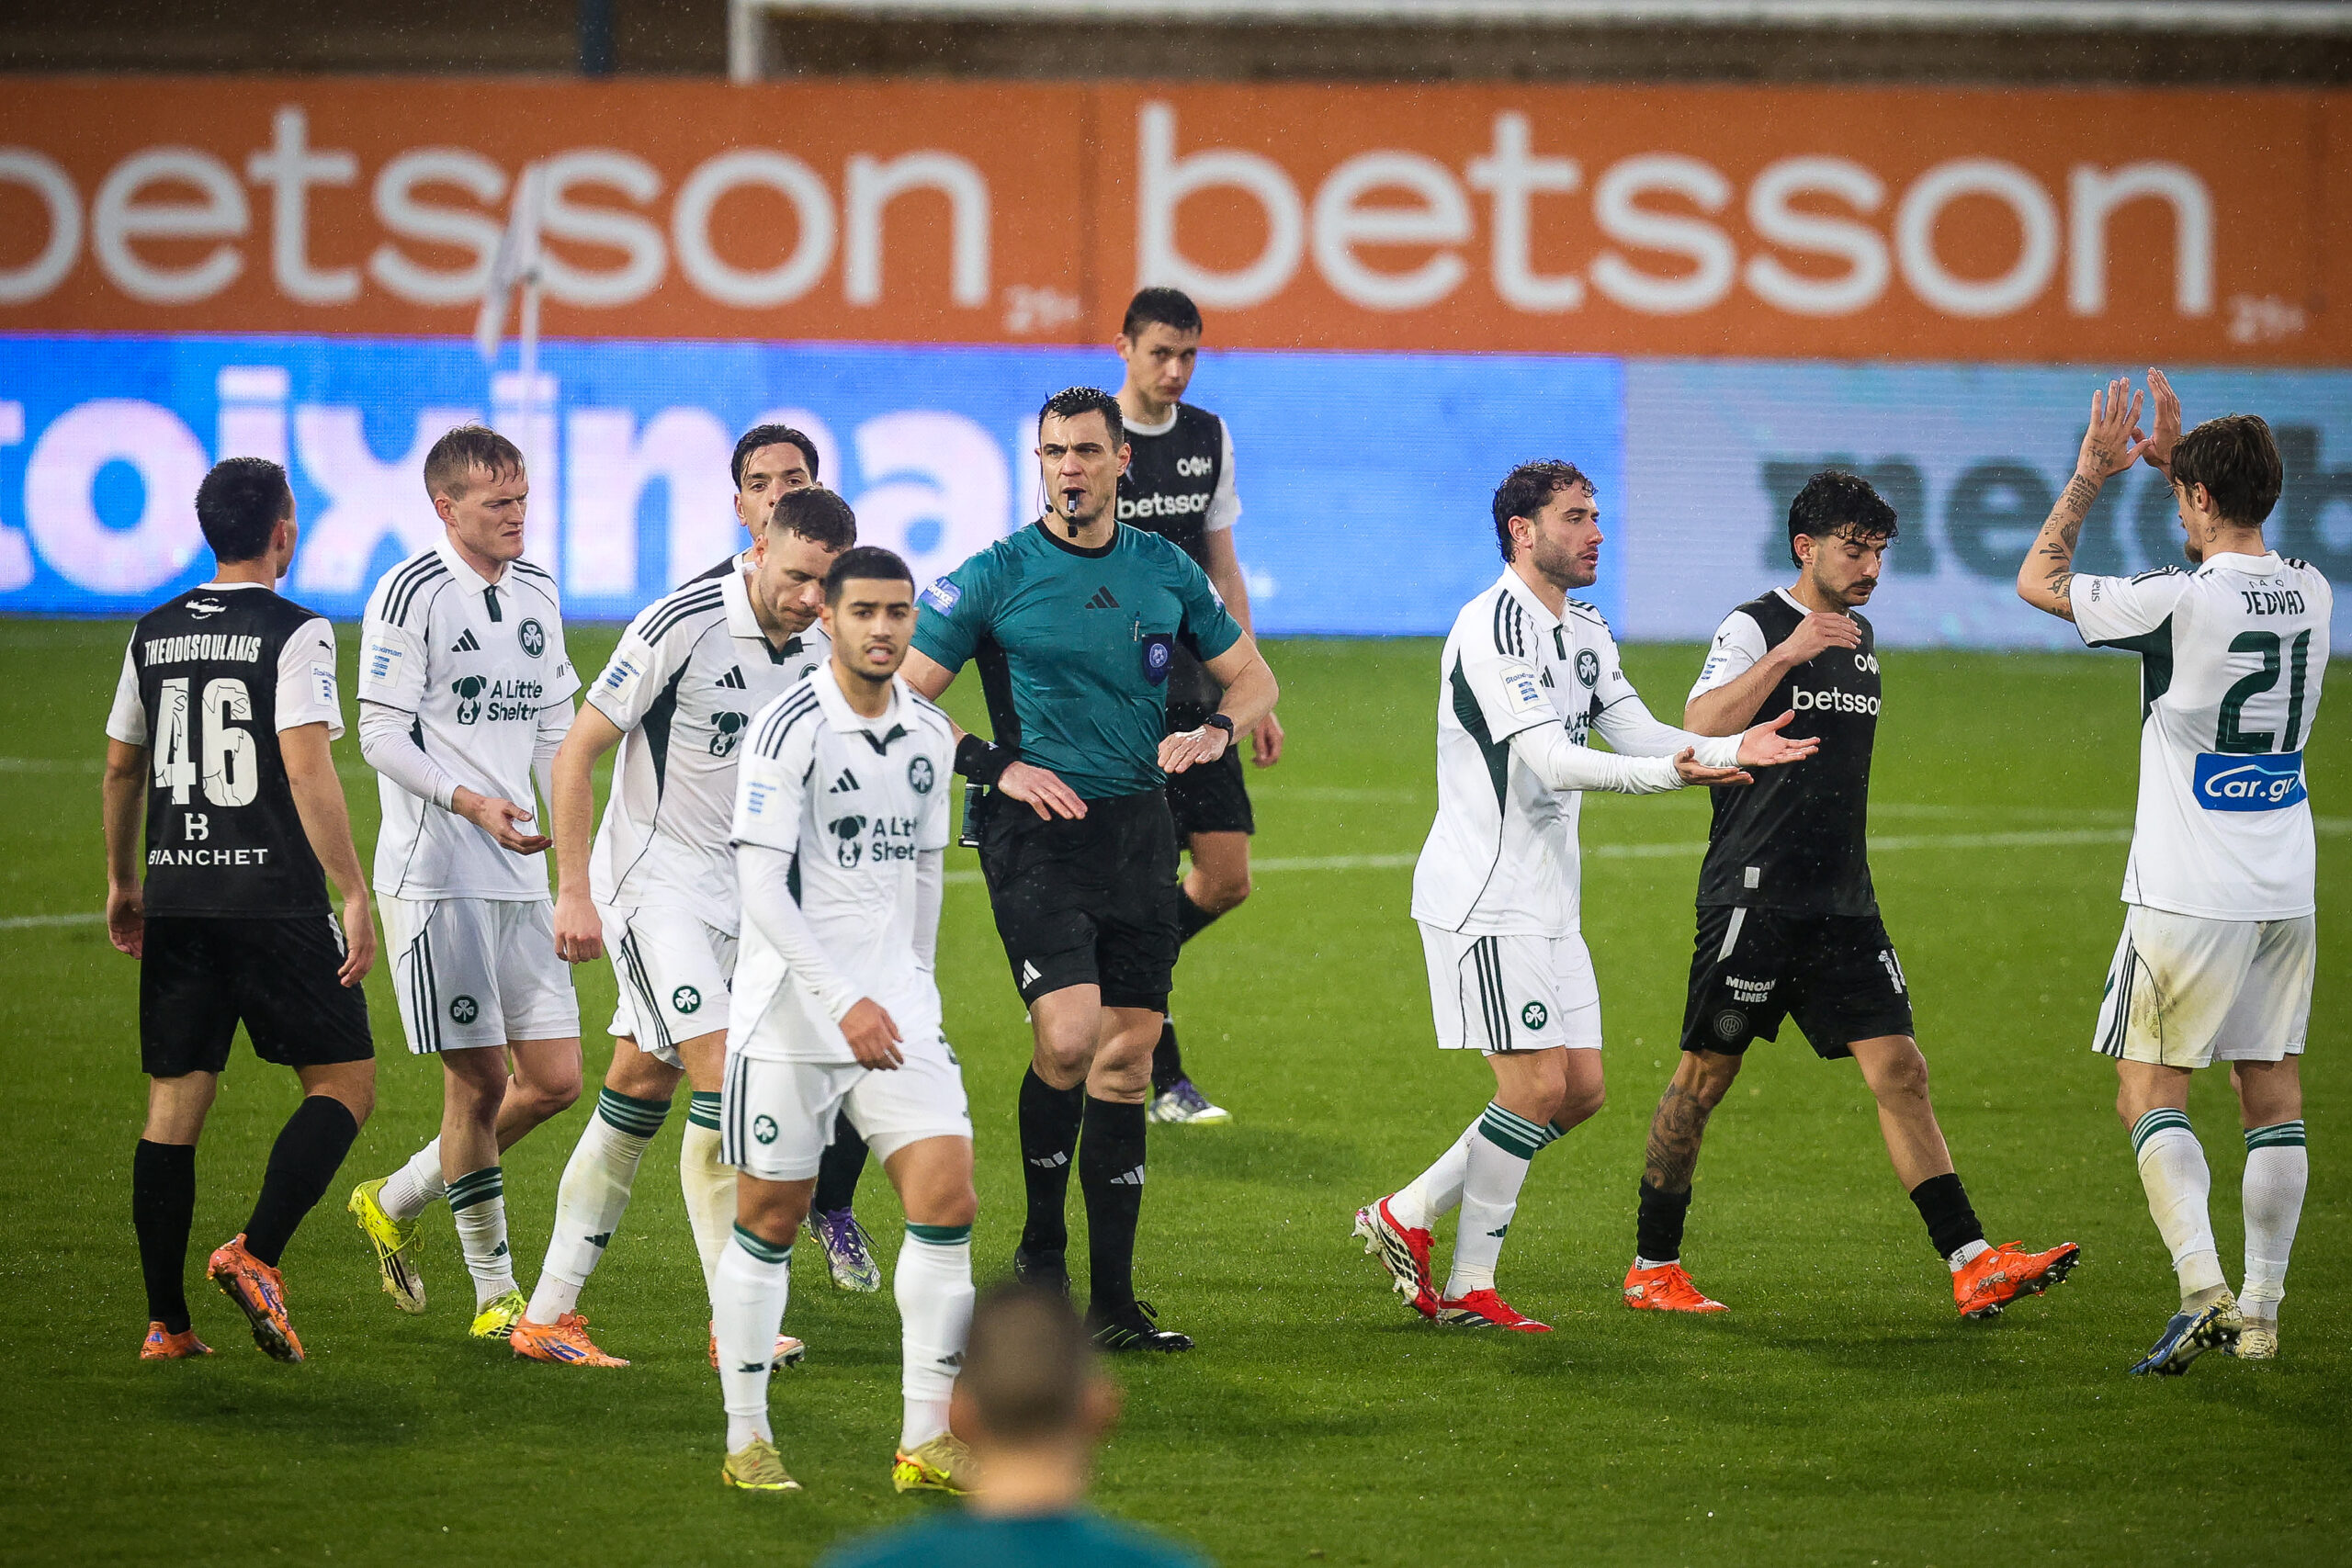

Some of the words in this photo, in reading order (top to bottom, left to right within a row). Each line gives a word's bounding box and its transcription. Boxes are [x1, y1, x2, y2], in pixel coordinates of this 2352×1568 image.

[1138, 101, 2216, 317] betsson
[0, 365, 1044, 595] oixima
[2241, 591, 2305, 615] JEDVAJ
[144, 634, 262, 667] THEODOSOULAKIS
[1854, 653, 1880, 674] ΟΦ
[490, 680, 503, 698] A
[2215, 628, 2312, 753] 21
[487, 701, 539, 721] Sheltr
[153, 677, 258, 807] 46
[2205, 774, 2297, 802] Car.gr
[872, 818, 887, 838] A
[148, 849, 268, 865] BIANCHET
[1734, 990, 1768, 1003] LINES
